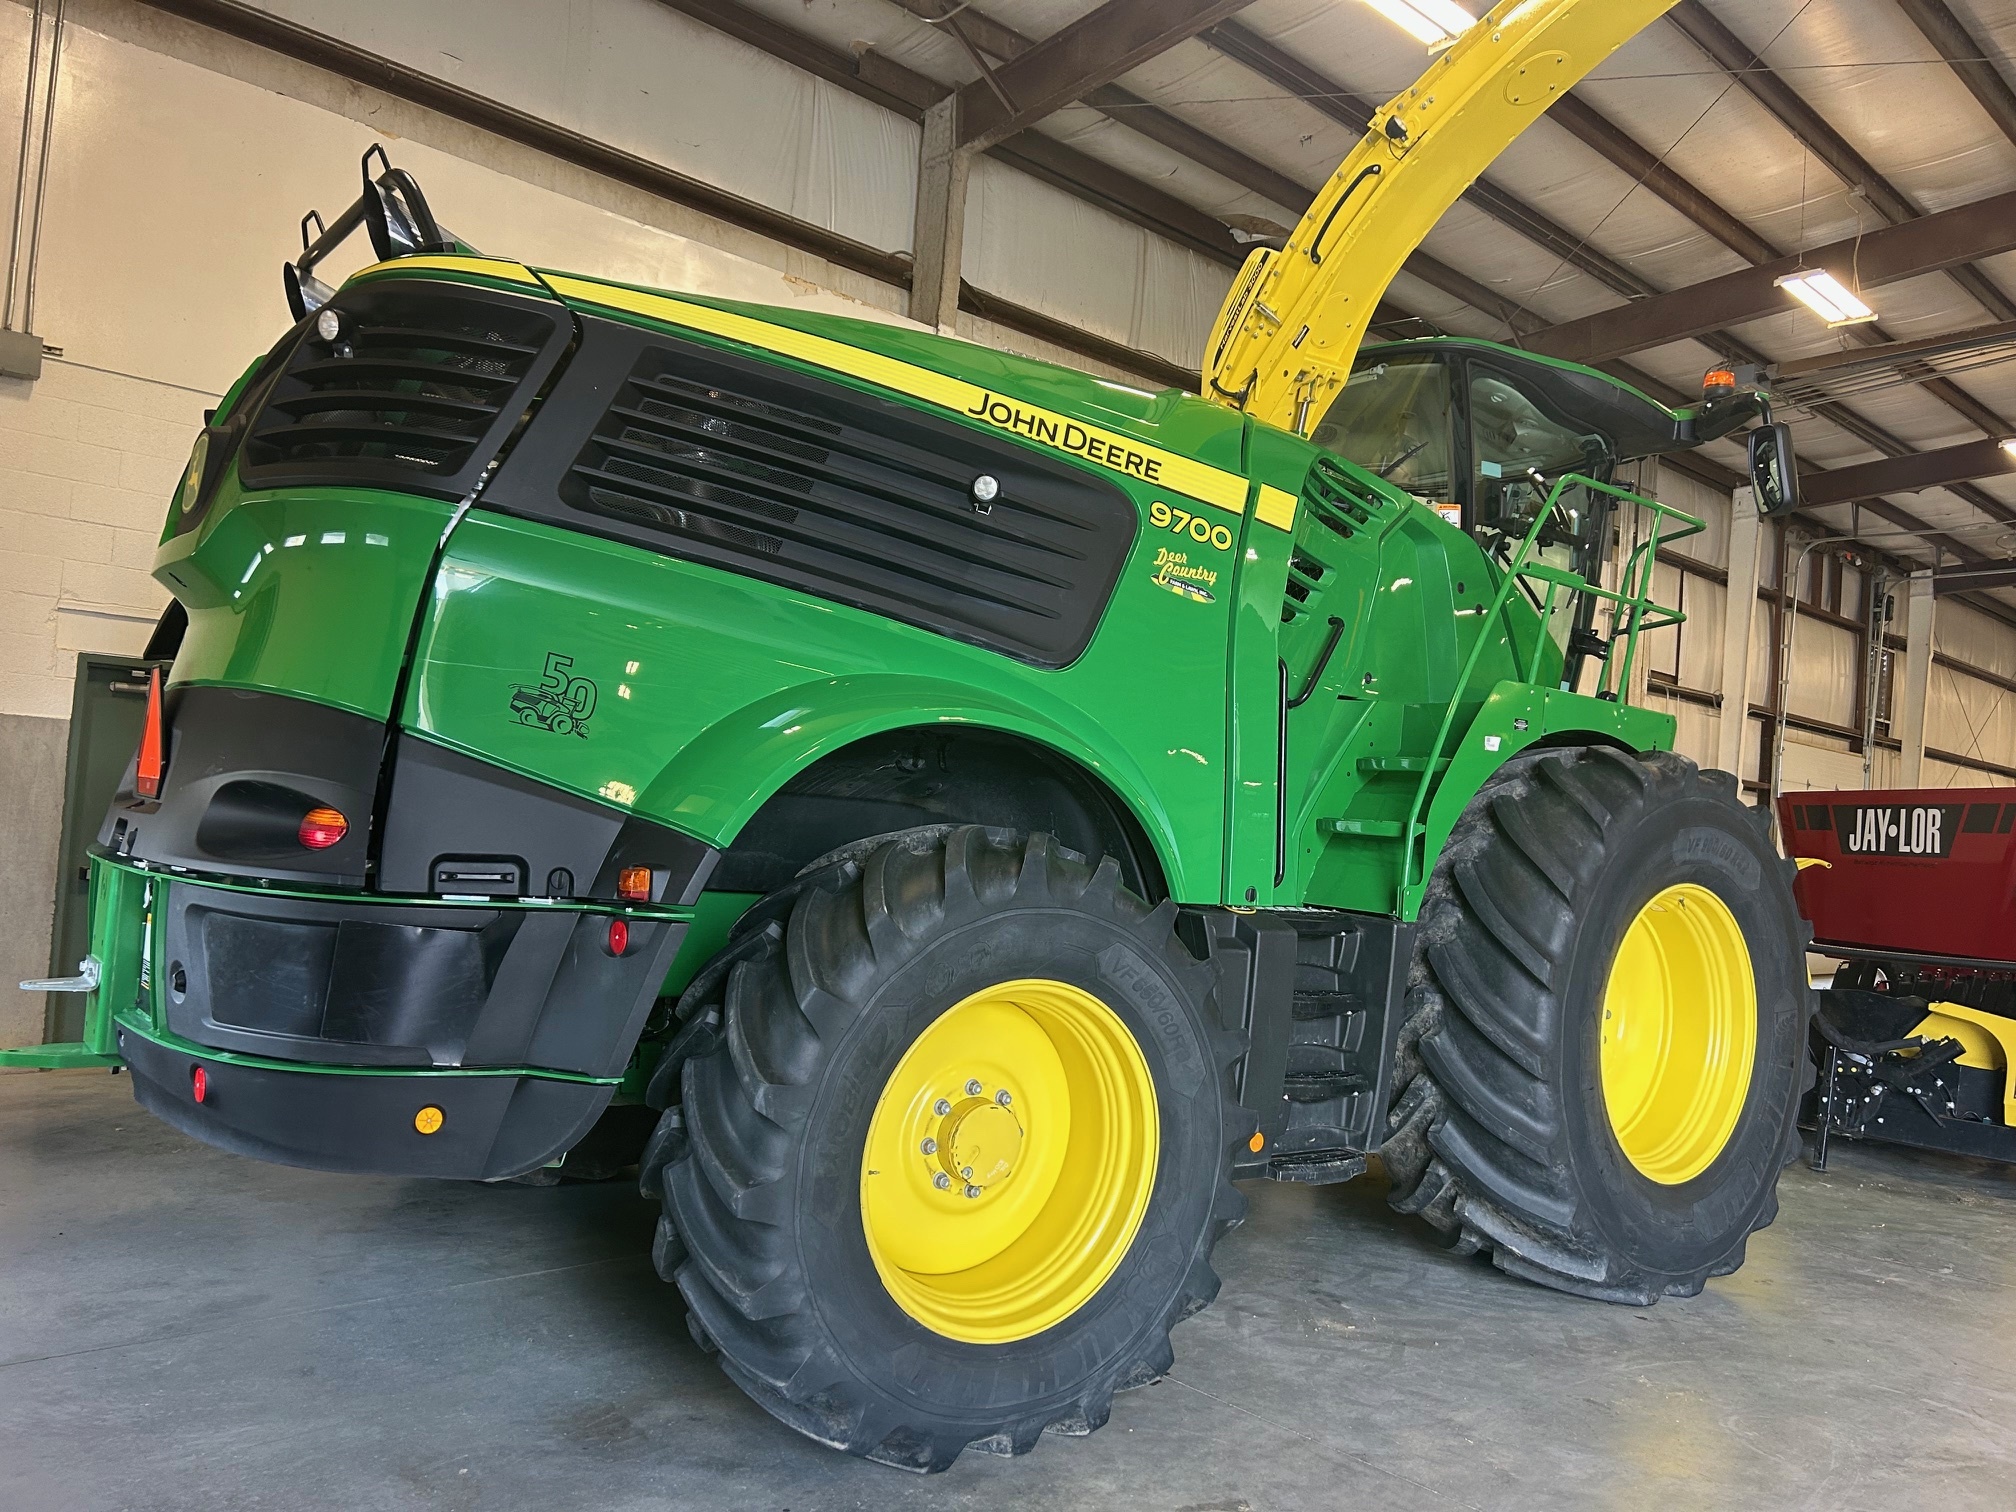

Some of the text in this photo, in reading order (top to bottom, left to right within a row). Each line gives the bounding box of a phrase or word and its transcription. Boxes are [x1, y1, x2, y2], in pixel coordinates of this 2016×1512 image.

[1247, 262, 1263, 290] 3000
[967, 393, 1162, 482] JOHN DEERE
[1149, 501, 1234, 551] 9700
[1153, 547, 1188, 566] Deer
[1158, 562, 1218, 587] Country
[540, 651, 598, 721] 50
